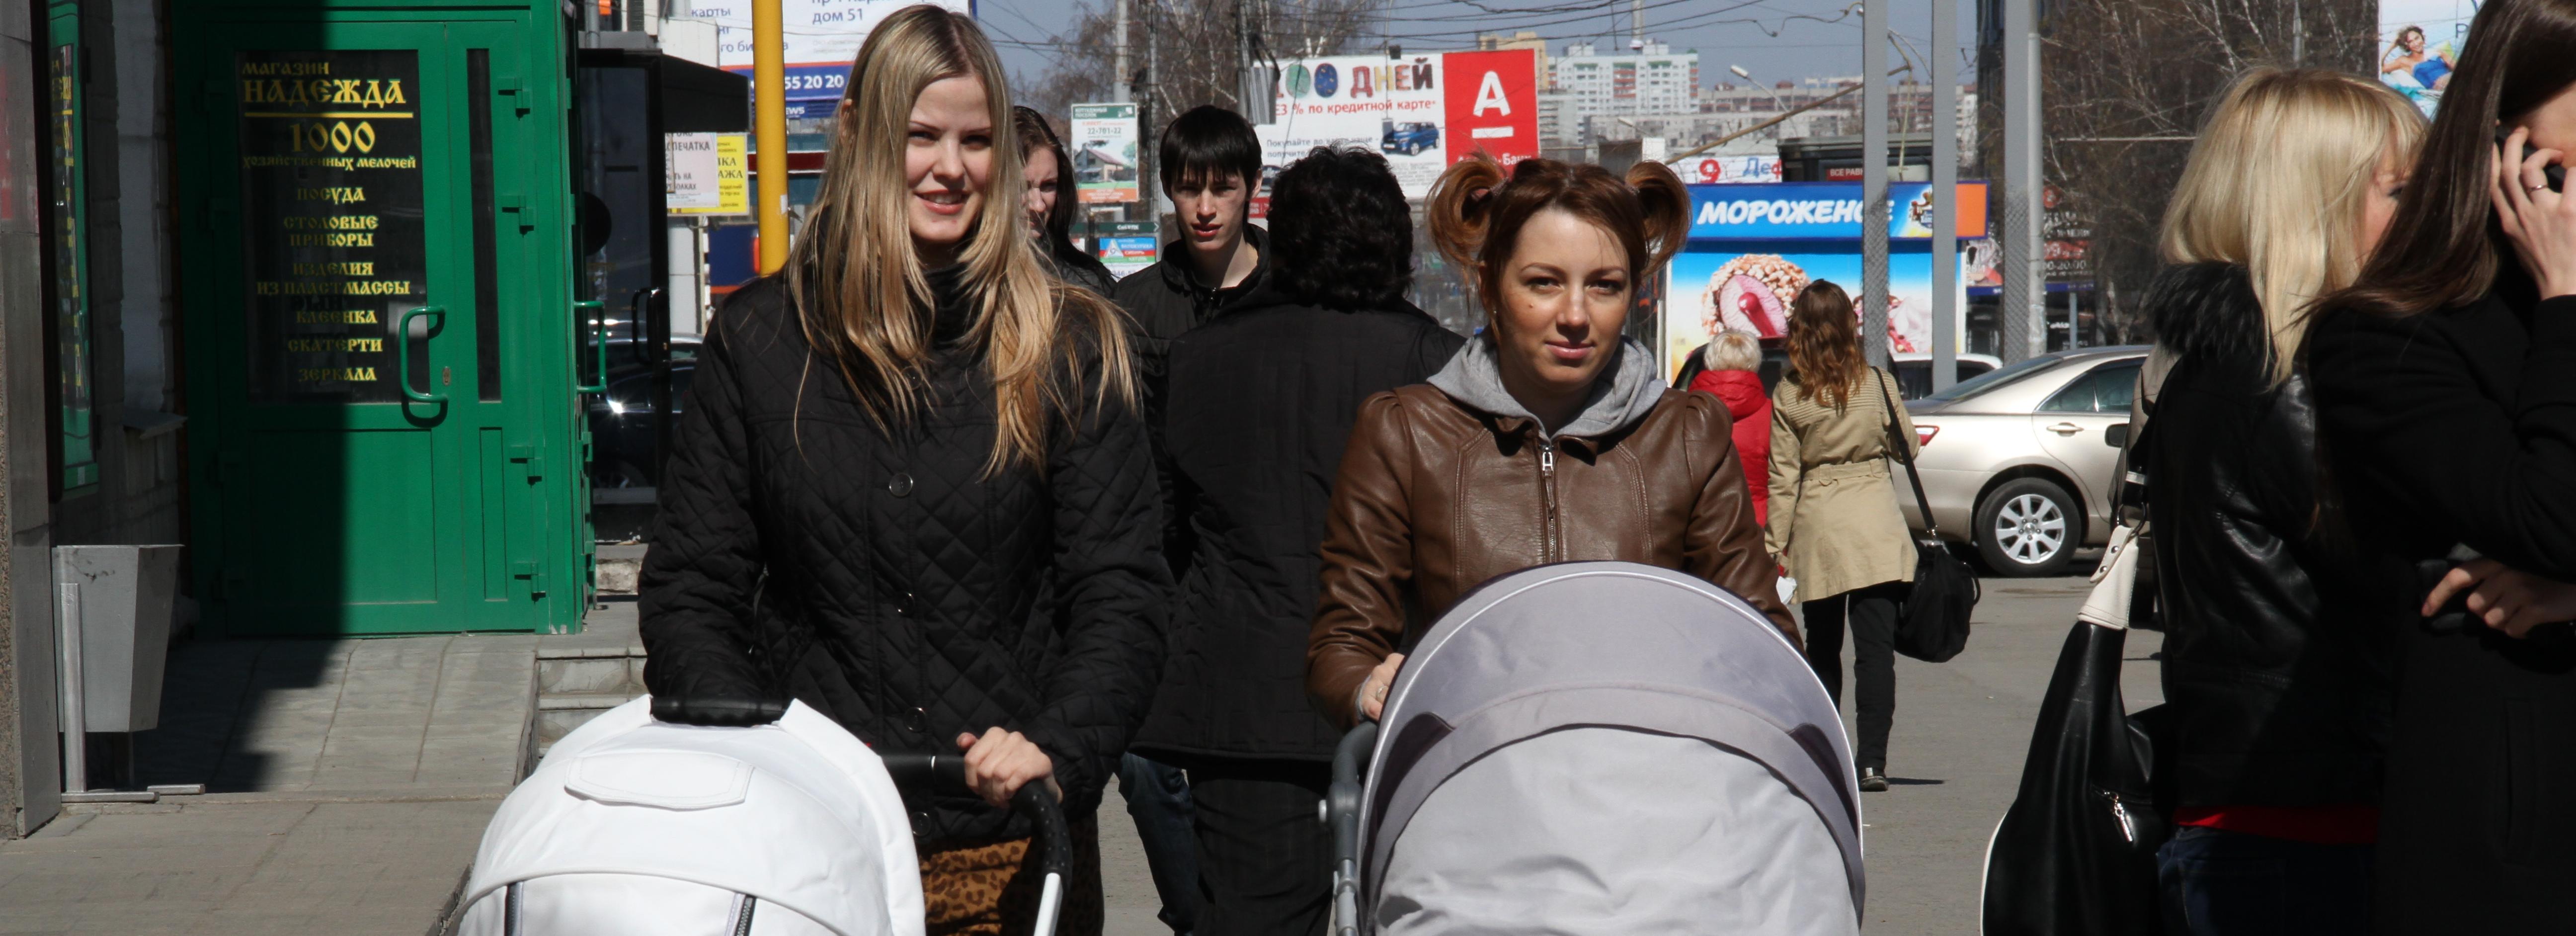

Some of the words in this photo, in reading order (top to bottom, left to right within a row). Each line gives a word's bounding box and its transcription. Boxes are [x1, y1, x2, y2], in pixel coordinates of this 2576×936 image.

[812, 11, 843, 24] дом
[848, 8, 863, 21] 51
[804, 76, 823, 89] 20
[825, 75, 844, 88] 20
[1350, 57, 1434, 98] ДНЕЙ
[242, 79, 406, 108] НАДЕЖДА
[1309, 105, 1323, 114] по
[1328, 100, 1392, 115] кредитной
[290, 121, 375, 154] 1000
[1699, 159, 1721, 183] 9
[298, 187, 366, 204] ПОСУДА
[284, 215, 379, 230] СТОЛОВЫЕ
[290, 233, 374, 247] ПРИБОРЫ
[293, 262, 374, 277] ИЗДЕЛИЯ
[257, 282, 279, 296] ИЗ
[284, 281, 411, 295] ПЛАСТМАССЫ
[296, 310, 378, 324] КЛЕЕНКА
[288, 339, 383, 352] СКАТЕРТИ
[298, 367, 377, 382] ЗЕРКАЛА
